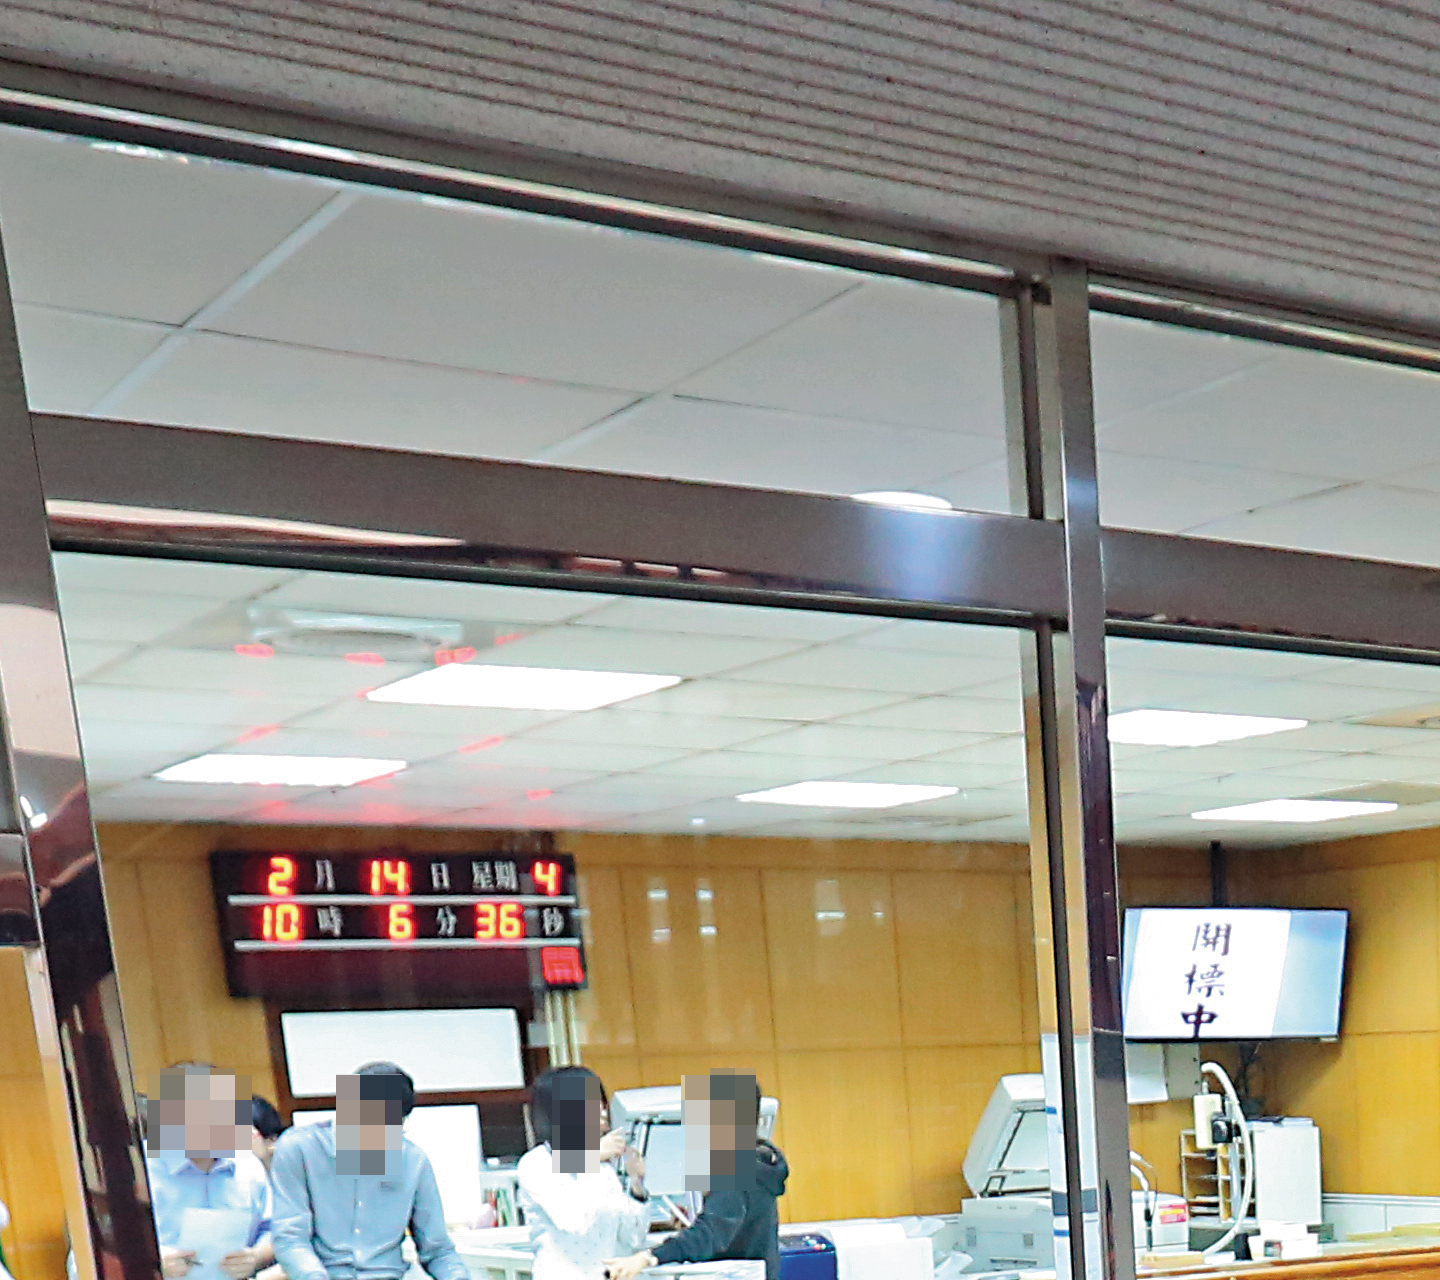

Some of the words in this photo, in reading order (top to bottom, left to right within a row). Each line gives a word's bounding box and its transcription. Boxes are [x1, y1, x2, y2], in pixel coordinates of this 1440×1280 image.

[267, 857, 295, 895] 2
[370, 860, 407, 894] 14
[533, 861, 558, 894] 4
[263, 904, 300, 941] 10
[389, 904, 411, 940] 6
[476, 903, 521, 941] 36
[1180, 922, 1232, 1039] 開標中
